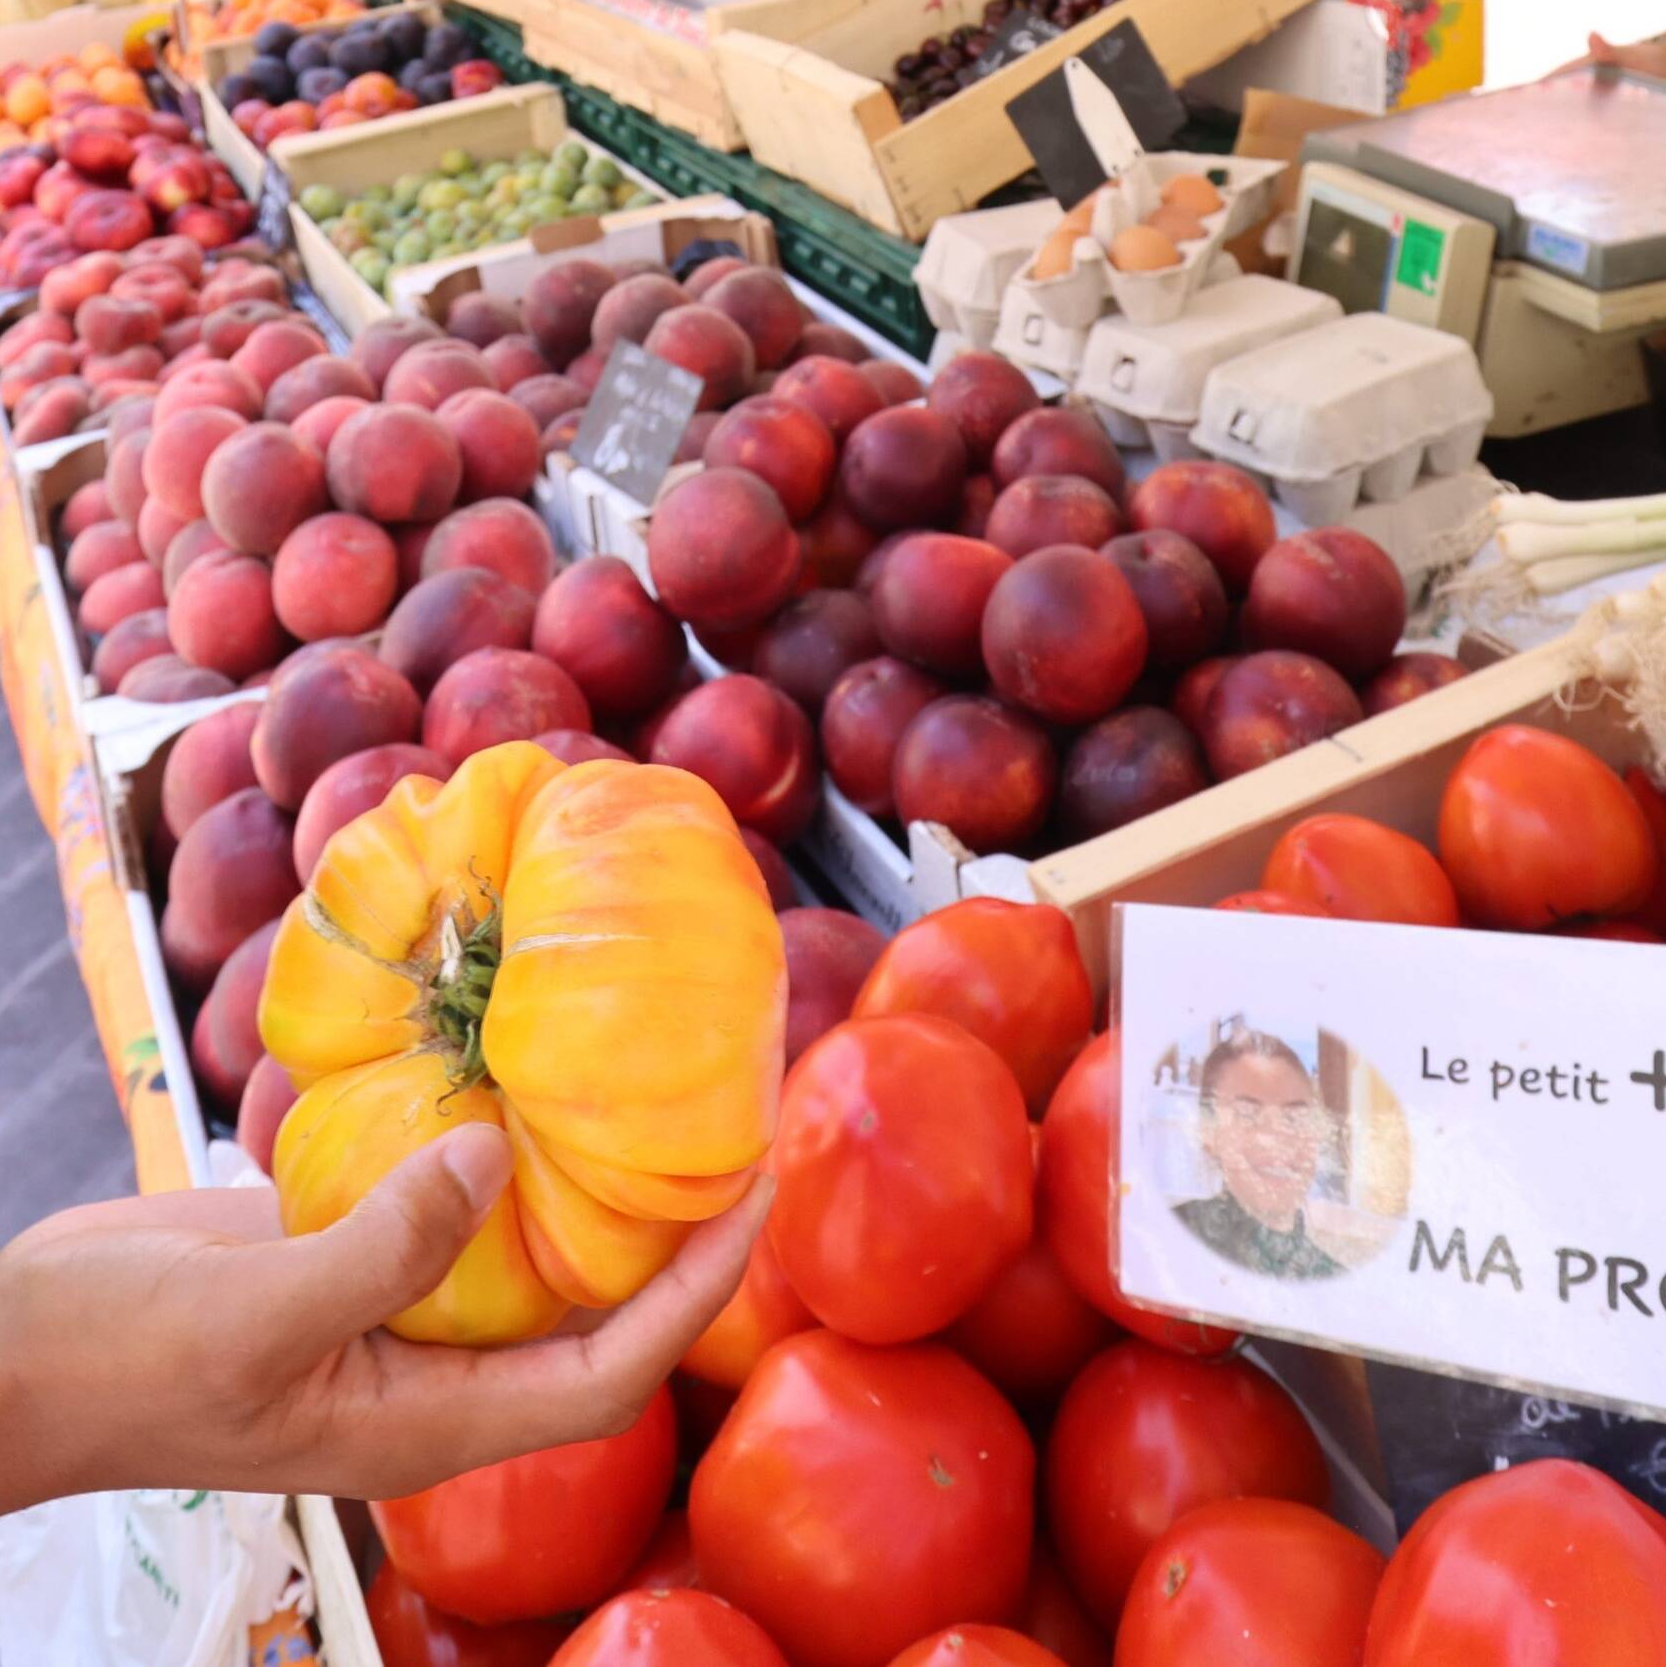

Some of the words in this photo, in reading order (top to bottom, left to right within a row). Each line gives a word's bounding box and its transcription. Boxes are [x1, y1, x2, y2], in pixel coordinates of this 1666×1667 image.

[1420, 1045, 1470, 1084] Le
[1489, 1060, 1610, 1105] petit
[1408, 1219, 1524, 1293] MA
